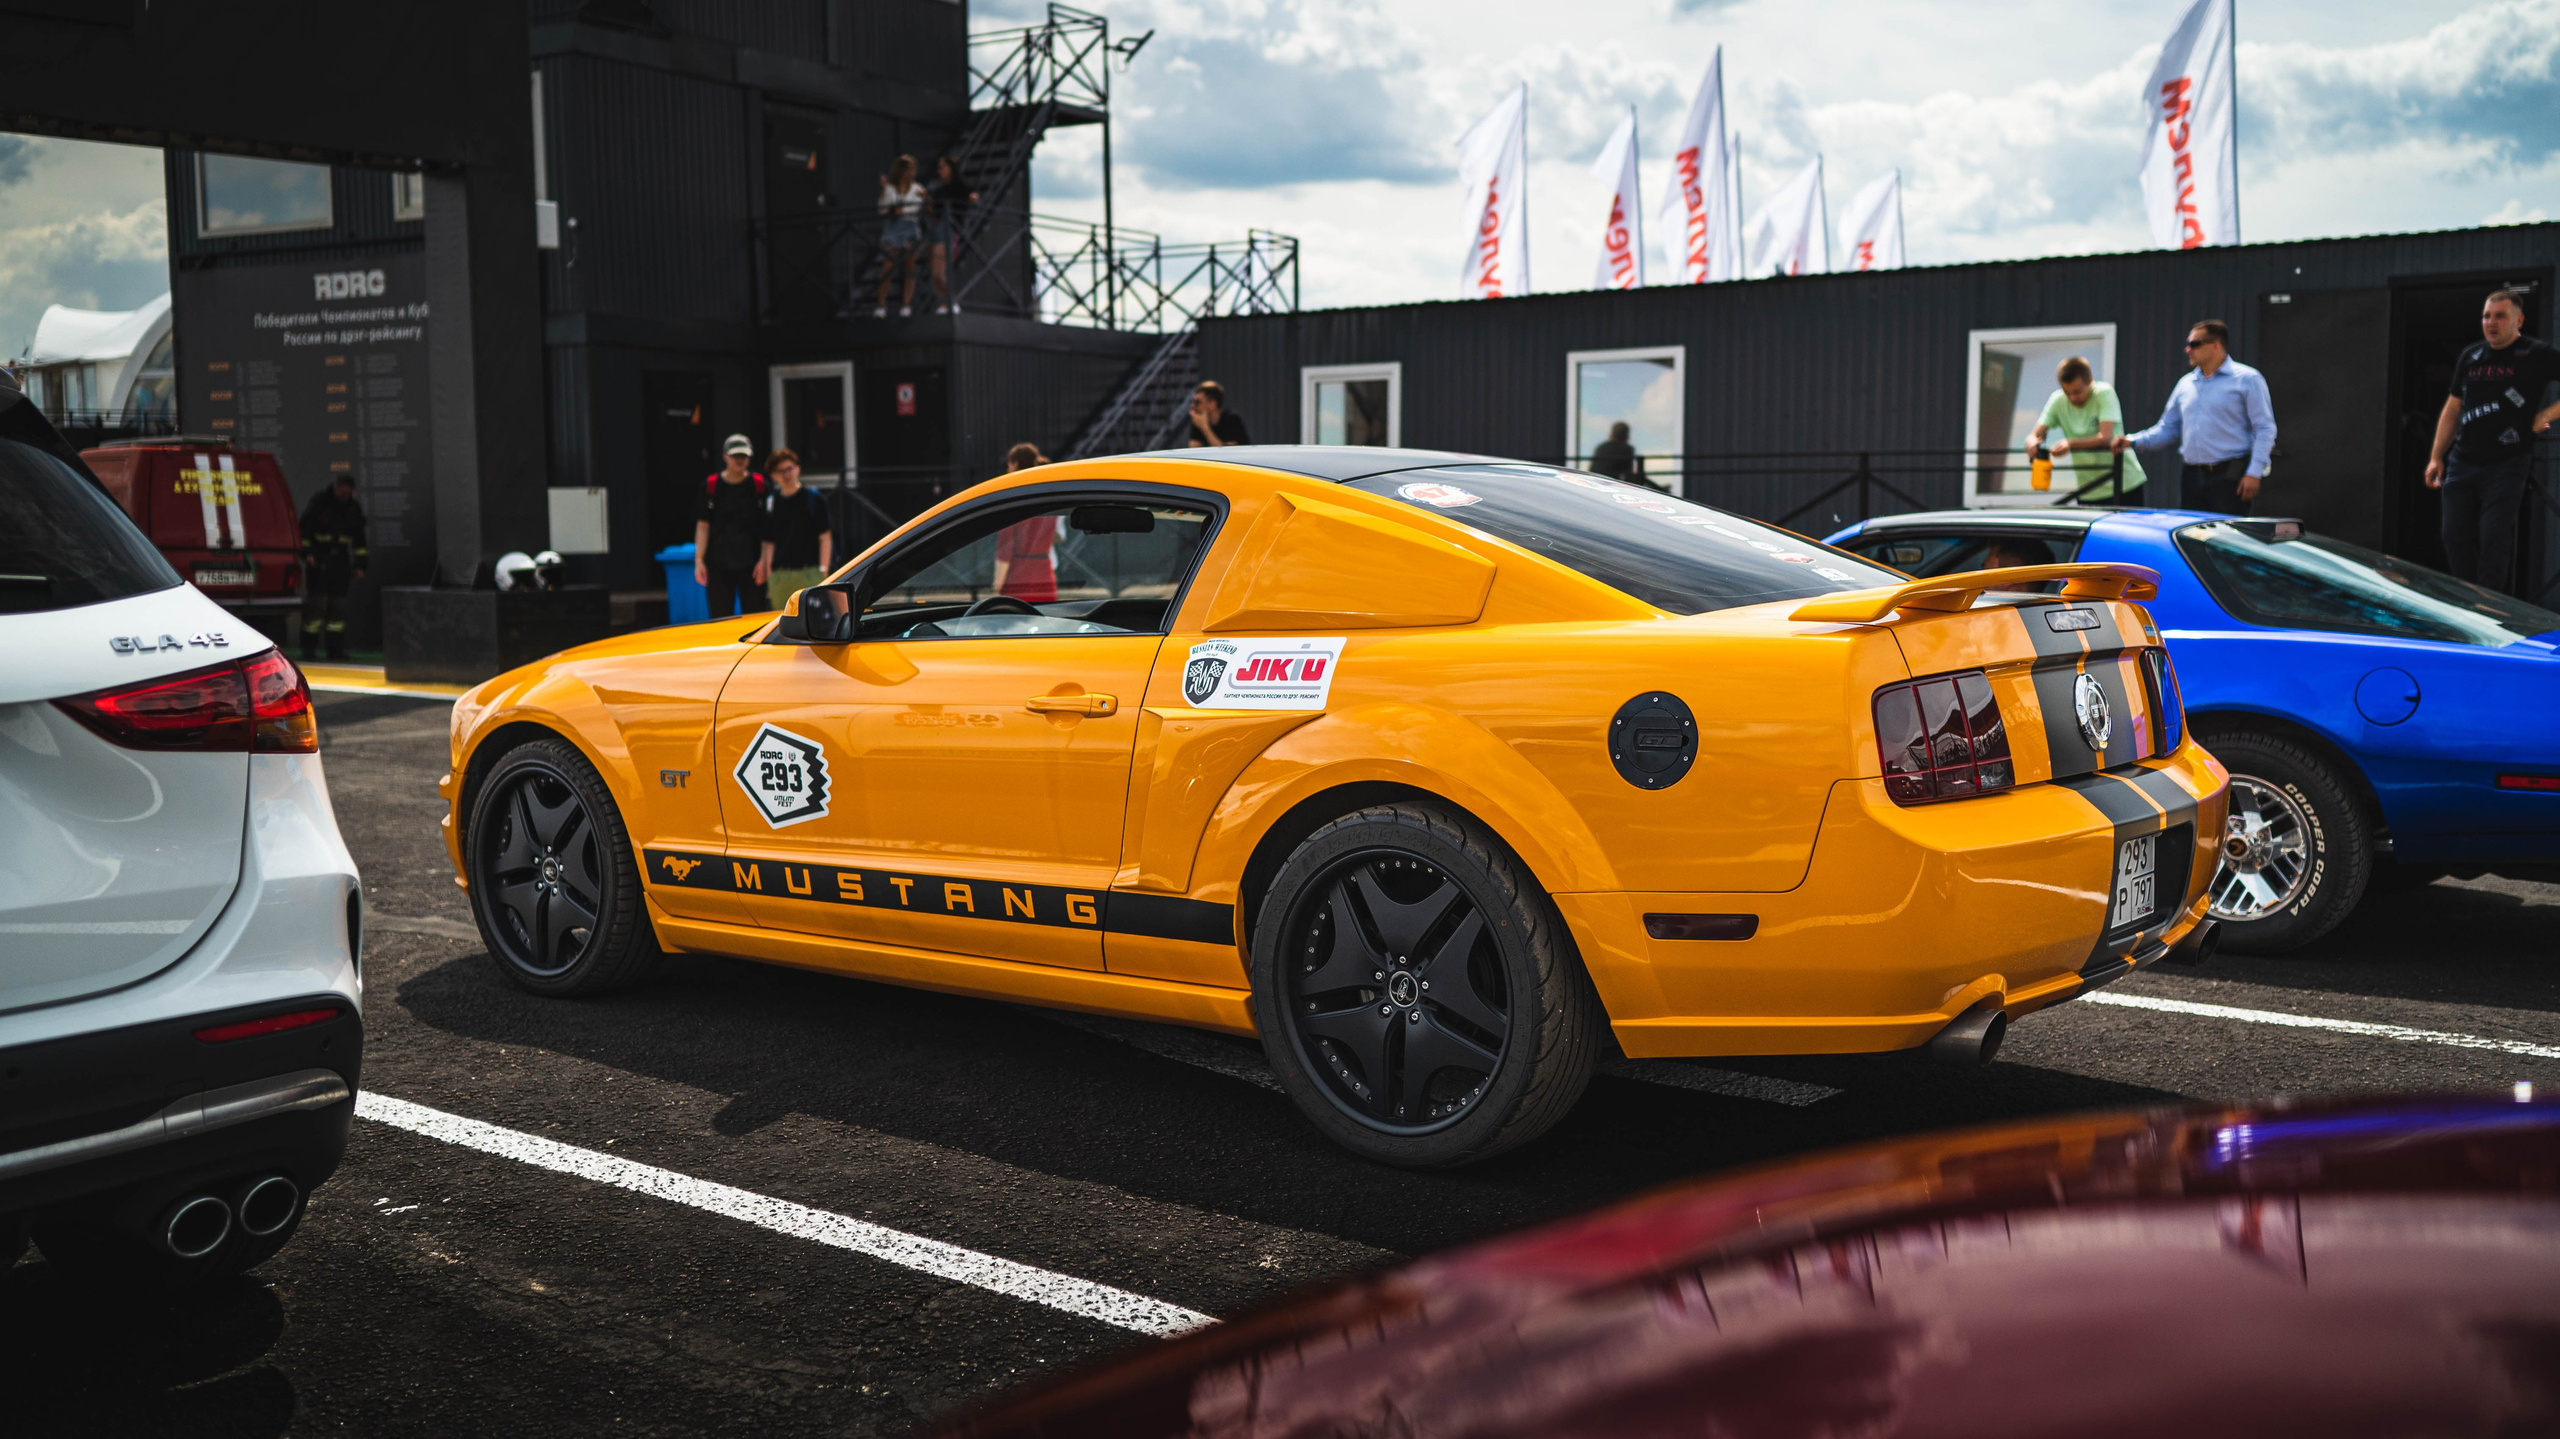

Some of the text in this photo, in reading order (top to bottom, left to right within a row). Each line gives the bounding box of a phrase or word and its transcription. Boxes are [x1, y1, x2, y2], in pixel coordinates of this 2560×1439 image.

[314, 269, 386, 300] RDRC
[254, 313, 318, 328] Победители
[321, 306, 395, 324] Чемпионатов
[398, 308, 405, 317] и
[283, 326, 421, 346] России по дрэг-рейсингу
[110, 631, 230, 653] GLA 45
[1235, 656, 1327, 682] JIKIU
[760, 750, 783, 760] RDRC
[660, 769, 690, 788] GT
[760, 761, 803, 793] 293
[2125, 837, 2148, 876] 293
[2284, 782, 2326, 917] COOPER COBRA
[732, 862, 1098, 925] MUSTANG
[2134, 876, 2152, 906] 797
[2136, 905, 2146, 915] RUS
